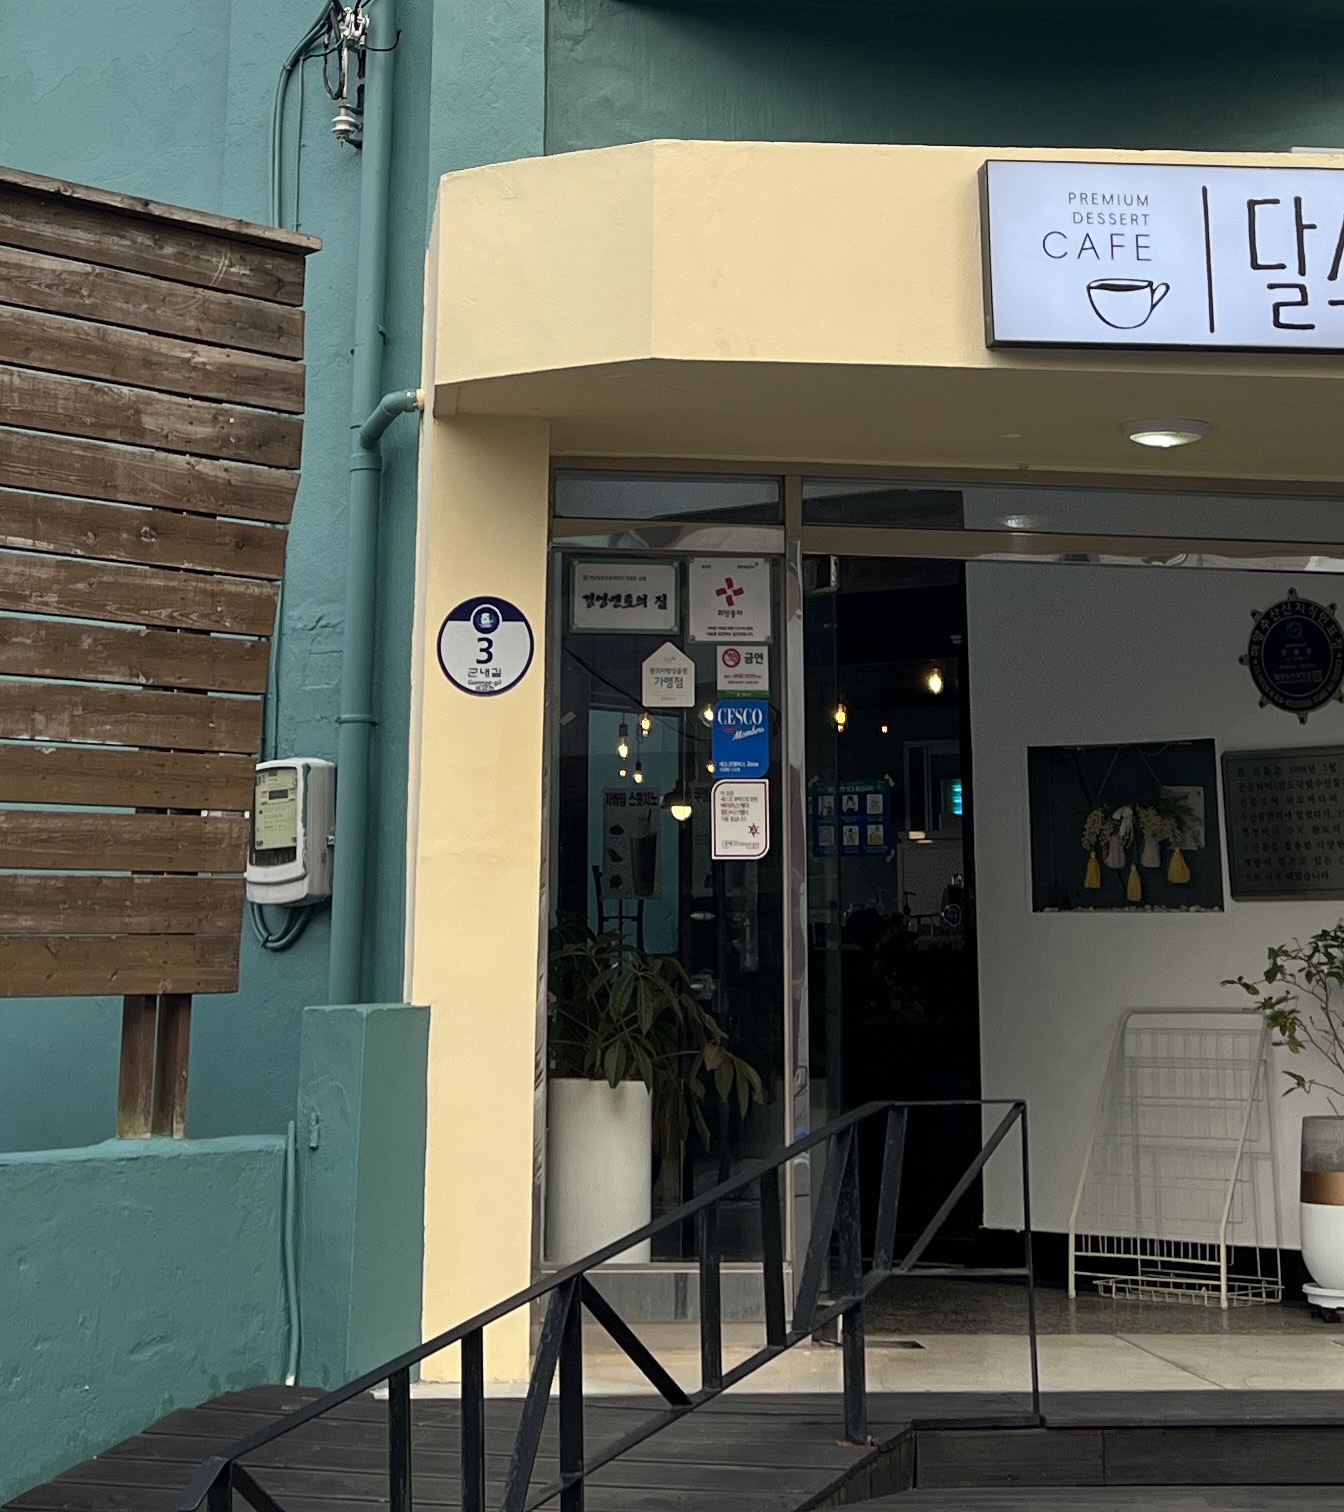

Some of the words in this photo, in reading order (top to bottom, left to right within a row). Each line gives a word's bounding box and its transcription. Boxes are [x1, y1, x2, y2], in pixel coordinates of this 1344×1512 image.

[1068, 192, 1149, 207] PREMIUM
[1072, 211, 1150, 226] DESSERT
[1042, 231, 1152, 262] CAFE
[476, 637, 493, 664] 3
[743, 652, 764, 665] 금연
[653, 676, 684, 689] 가맹점
[717, 707, 763, 725] CESCO
